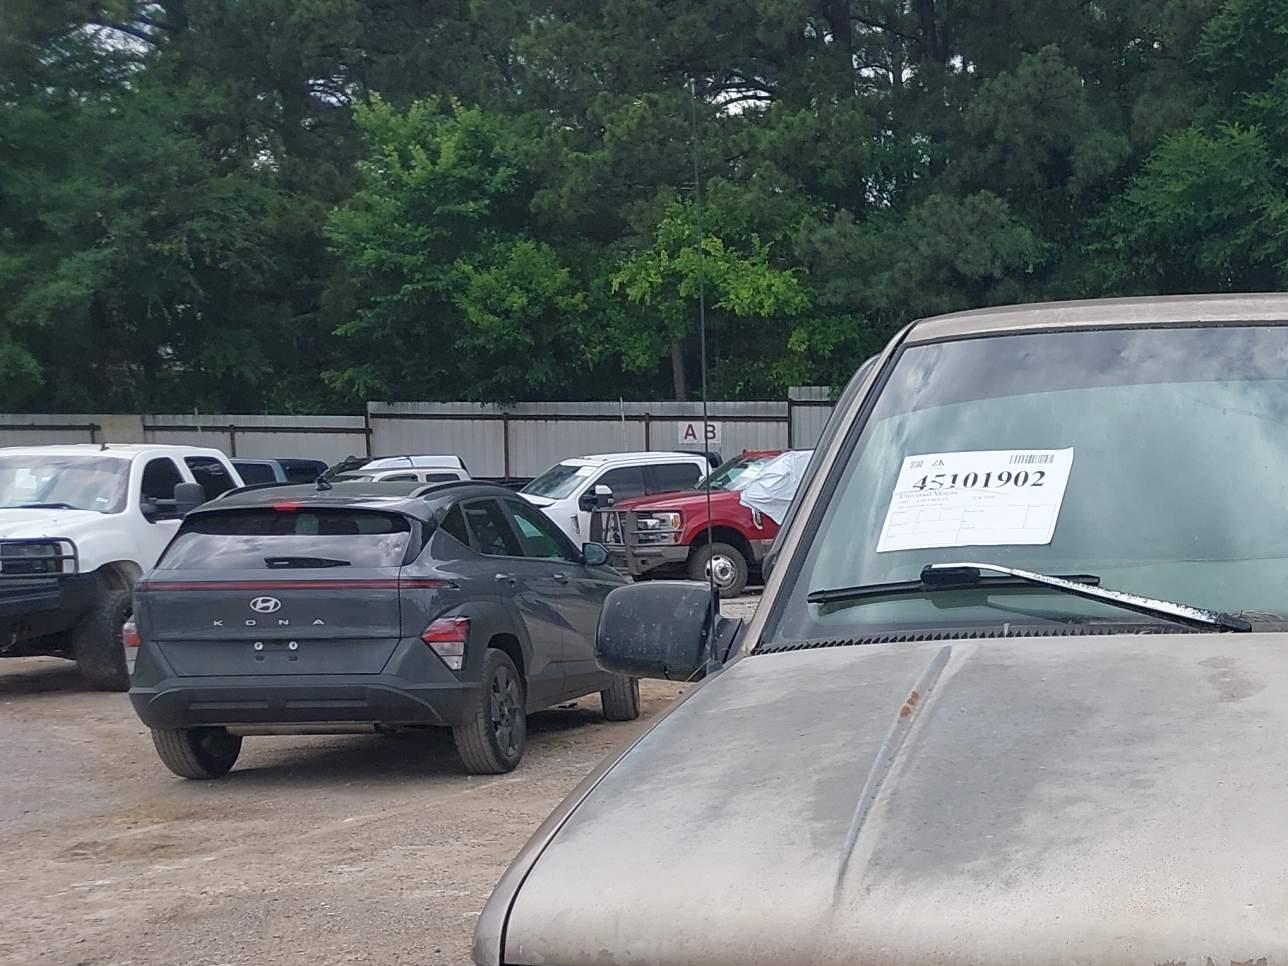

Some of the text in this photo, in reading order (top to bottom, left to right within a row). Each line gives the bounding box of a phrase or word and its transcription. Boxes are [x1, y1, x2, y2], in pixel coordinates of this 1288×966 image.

[684, 424, 717, 440] A B
[912, 469, 1046, 491] 45101902
[213, 619, 326, 627] KONA
